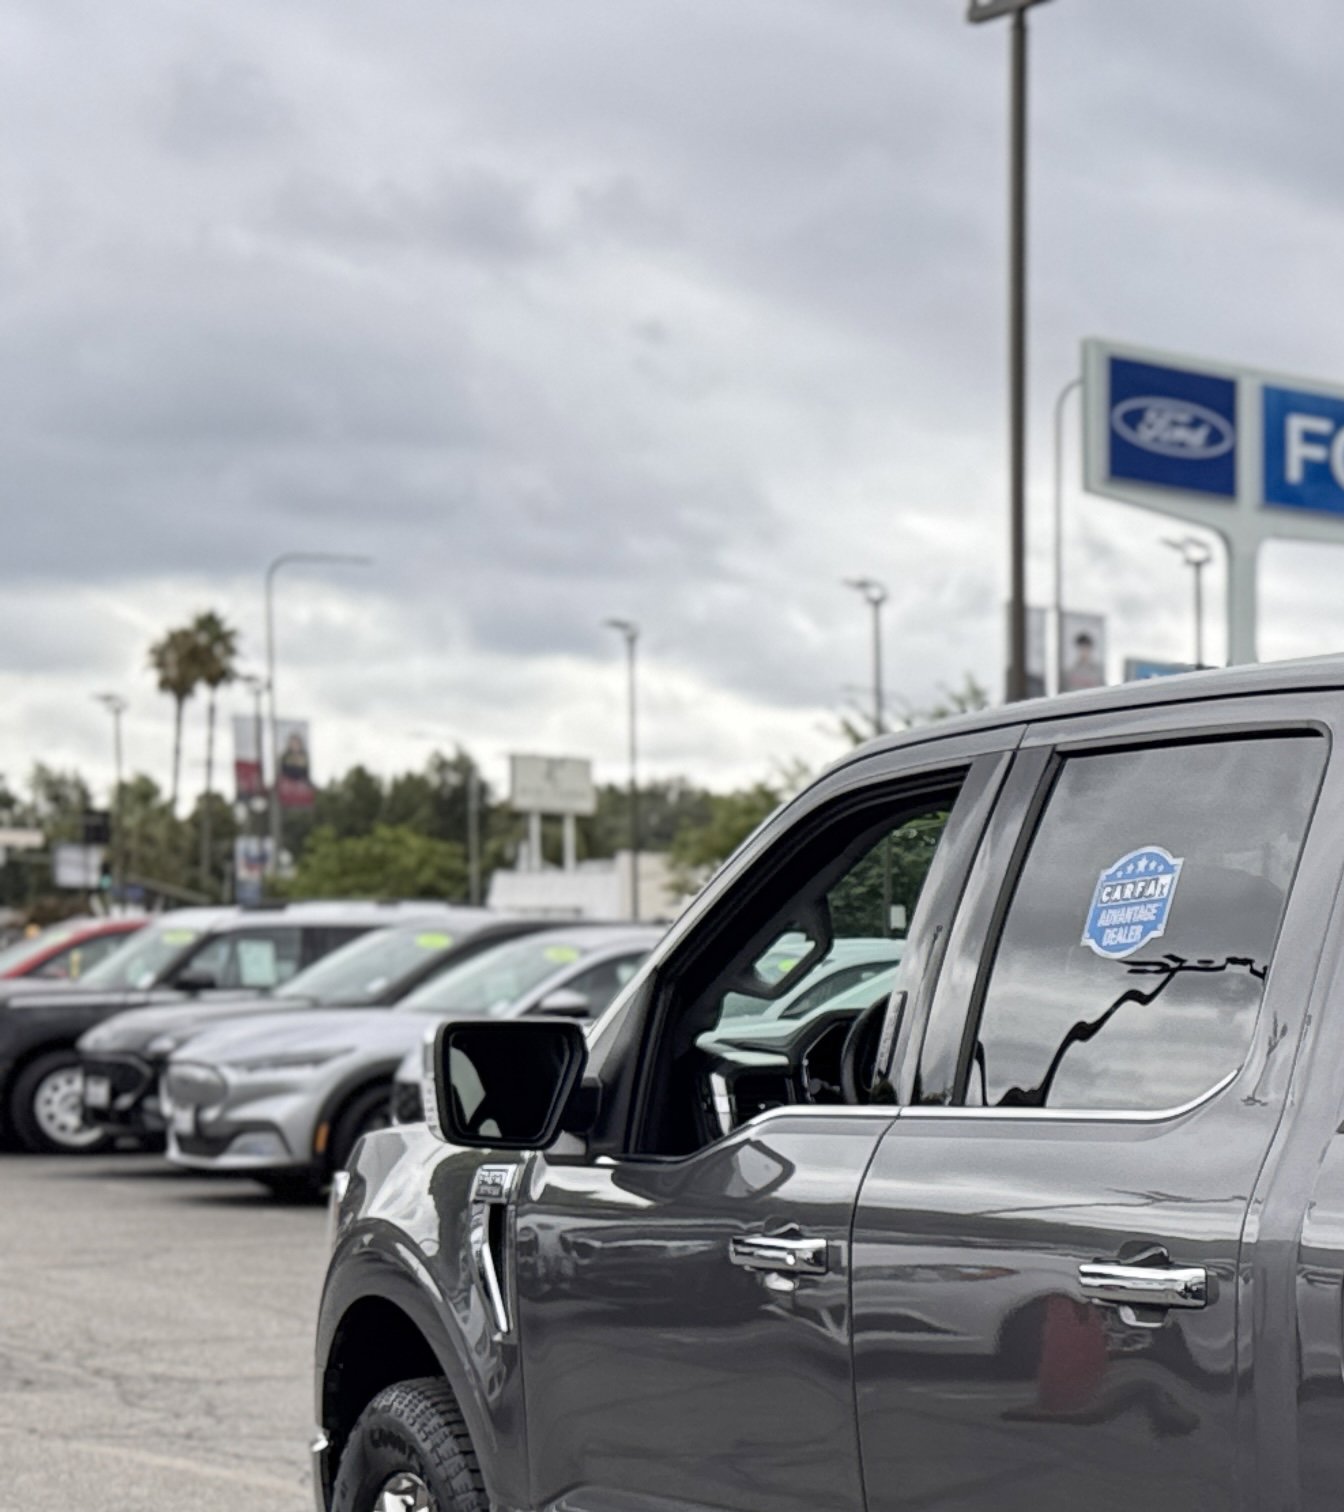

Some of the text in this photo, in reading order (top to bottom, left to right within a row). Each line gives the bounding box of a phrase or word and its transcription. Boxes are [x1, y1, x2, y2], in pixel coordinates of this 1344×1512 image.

[1136, 405, 1210, 450] Ford
[1097, 902, 1163, 928] ADVANTAGE
[1102, 924, 1144, 946] DEALER
